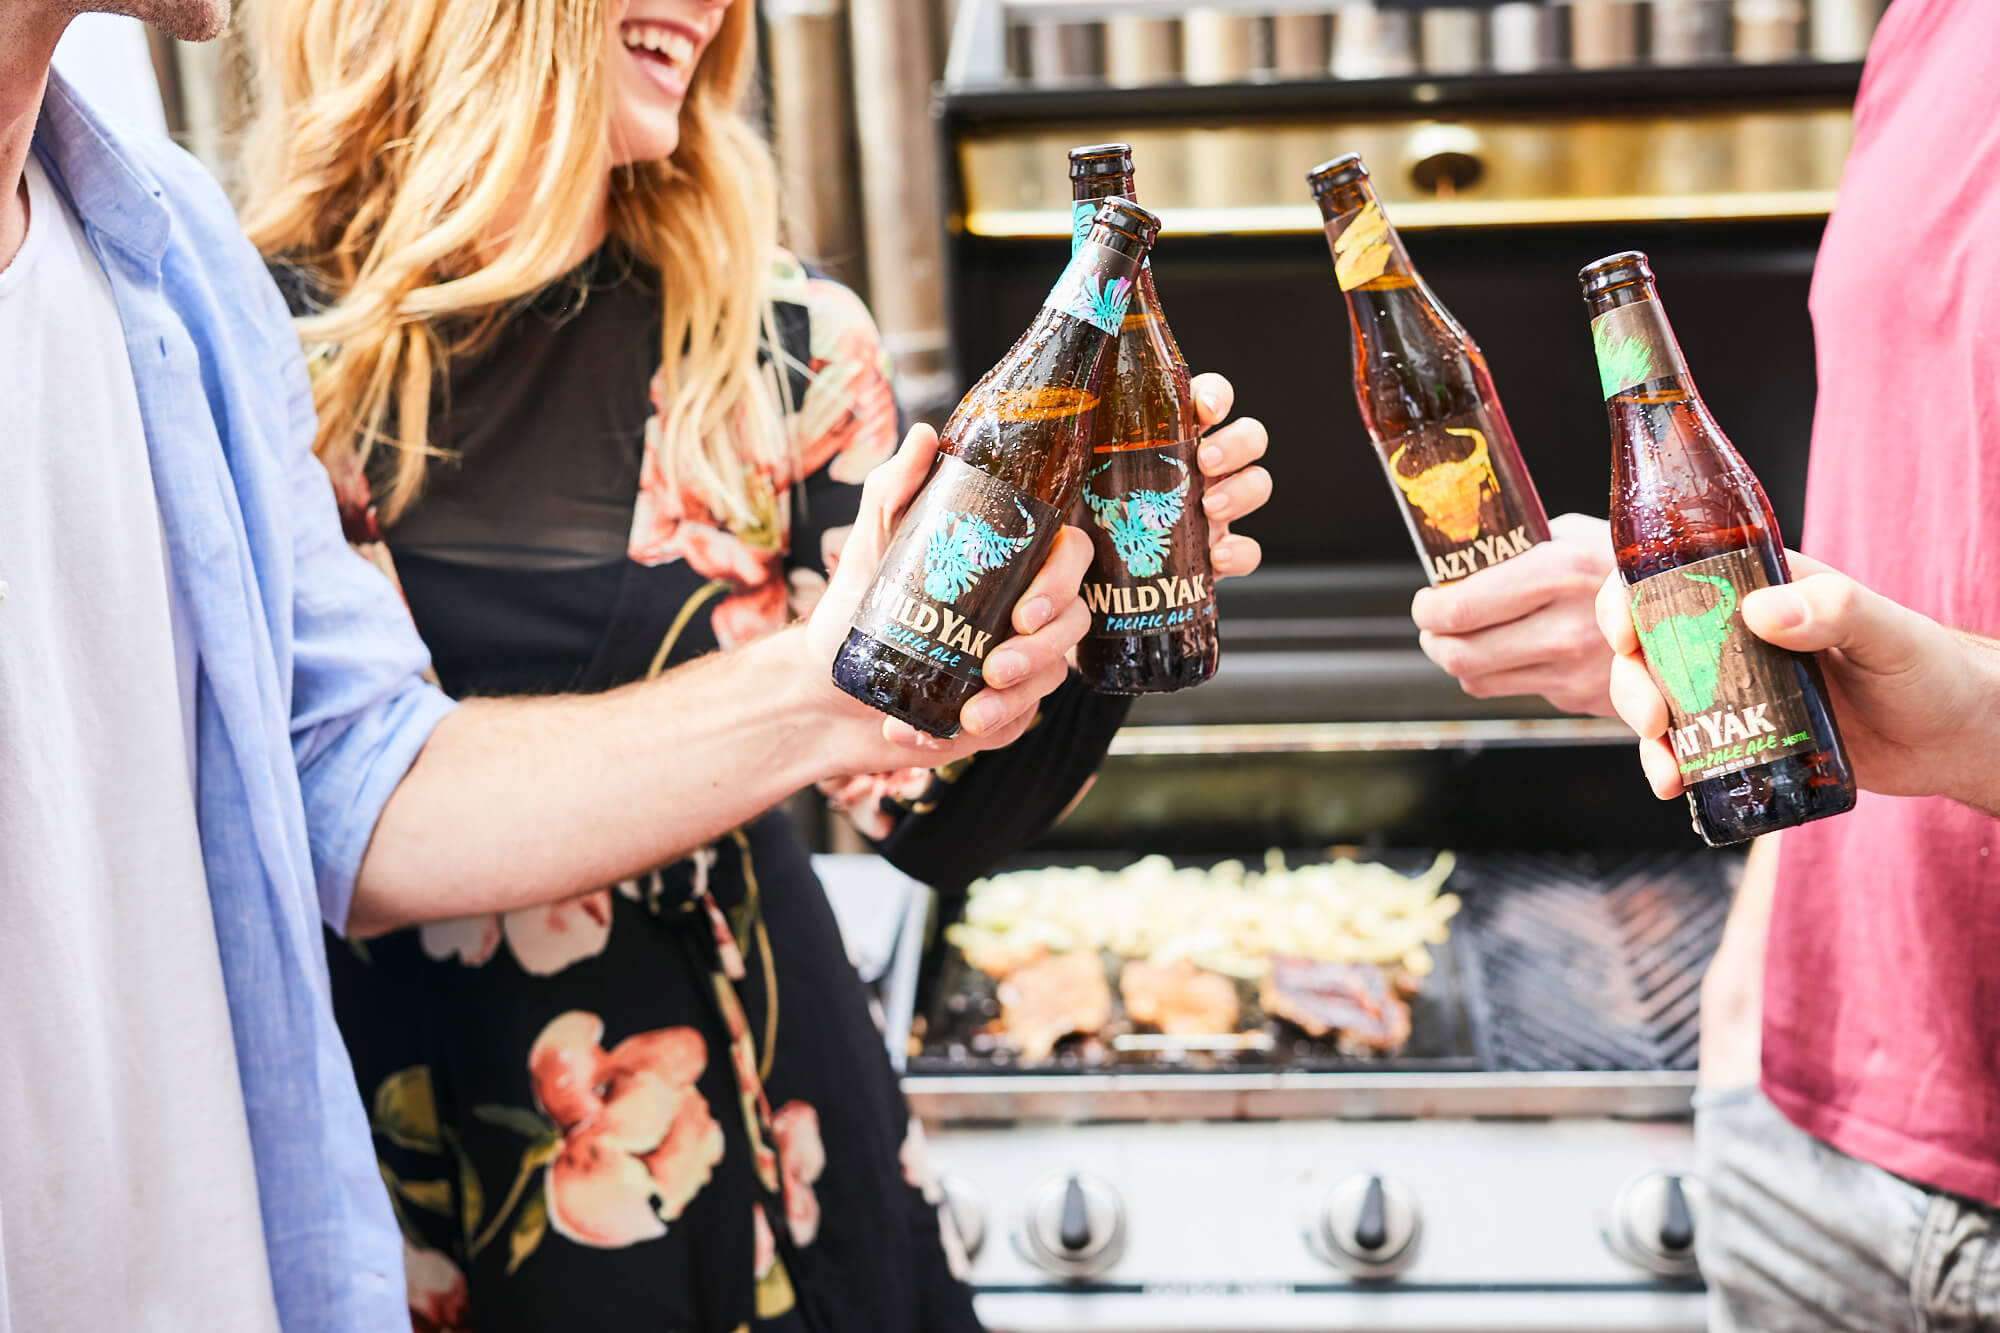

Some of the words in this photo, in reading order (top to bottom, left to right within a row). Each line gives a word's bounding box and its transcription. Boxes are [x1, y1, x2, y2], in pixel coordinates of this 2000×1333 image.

[1474, 525, 1532, 567] YAK
[1083, 582, 1160, 614] WILD
[1157, 573, 1207, 609] YAK
[936, 607, 992, 660] YAK
[1106, 614, 1164, 632] PACIFIC
[1166, 607, 1194, 626] ALE
[928, 646, 962, 668] ALE
[1675, 724, 1701, 759] AT
[1695, 702, 1777, 748] YAK
[1706, 744, 1744, 769] PALE
[1745, 734, 1778, 756] ALE
